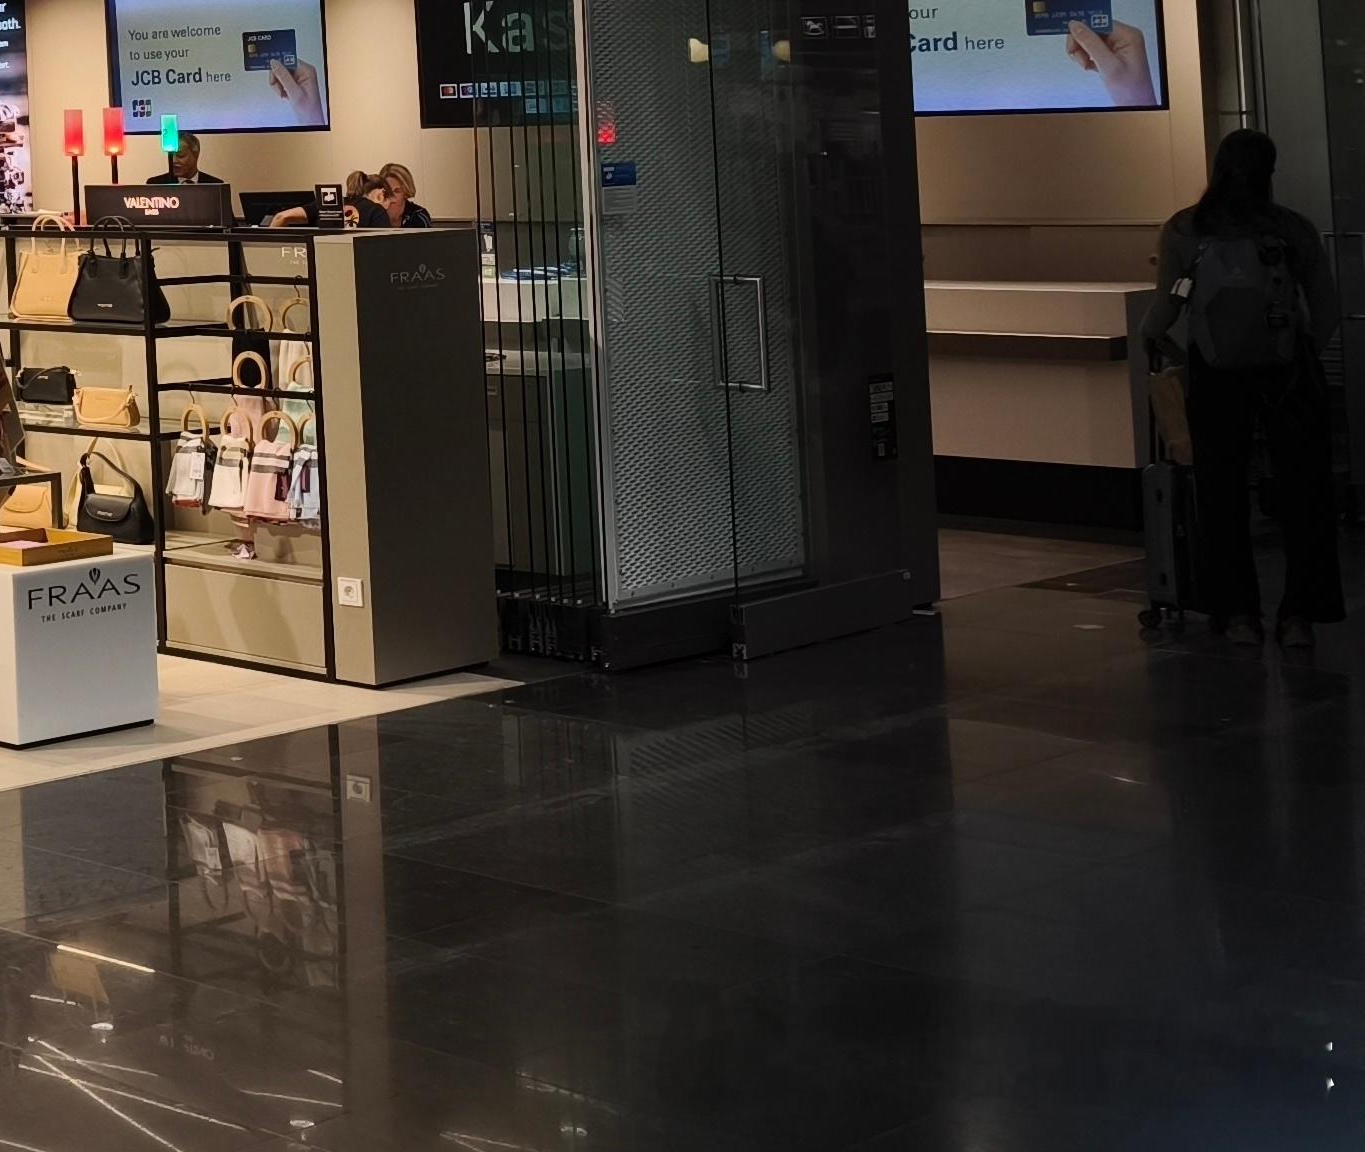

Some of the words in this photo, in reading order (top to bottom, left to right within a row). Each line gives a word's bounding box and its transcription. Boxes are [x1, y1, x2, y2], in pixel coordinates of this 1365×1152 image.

[907, 7, 939, 20] our
[128, 30, 149, 41] You
[152, 28, 169, 39] are
[171, 25, 222, 38] welcome
[964, 37, 1005, 50] here
[130, 50, 140, 61] to
[143, 51, 163, 59] use
[164, 49, 190, 62] your
[132, 70, 162, 86] JCB
[165, 67, 203, 84] Card
[206, 71, 232, 83] here
[123, 196, 180, 209] VALENTINO
[28, 573, 141, 610] FRAAS
[41, 614, 56, 623] THE
[61, 609, 85, 620] SCARF
[89, 603, 127, 615] COMPANY
